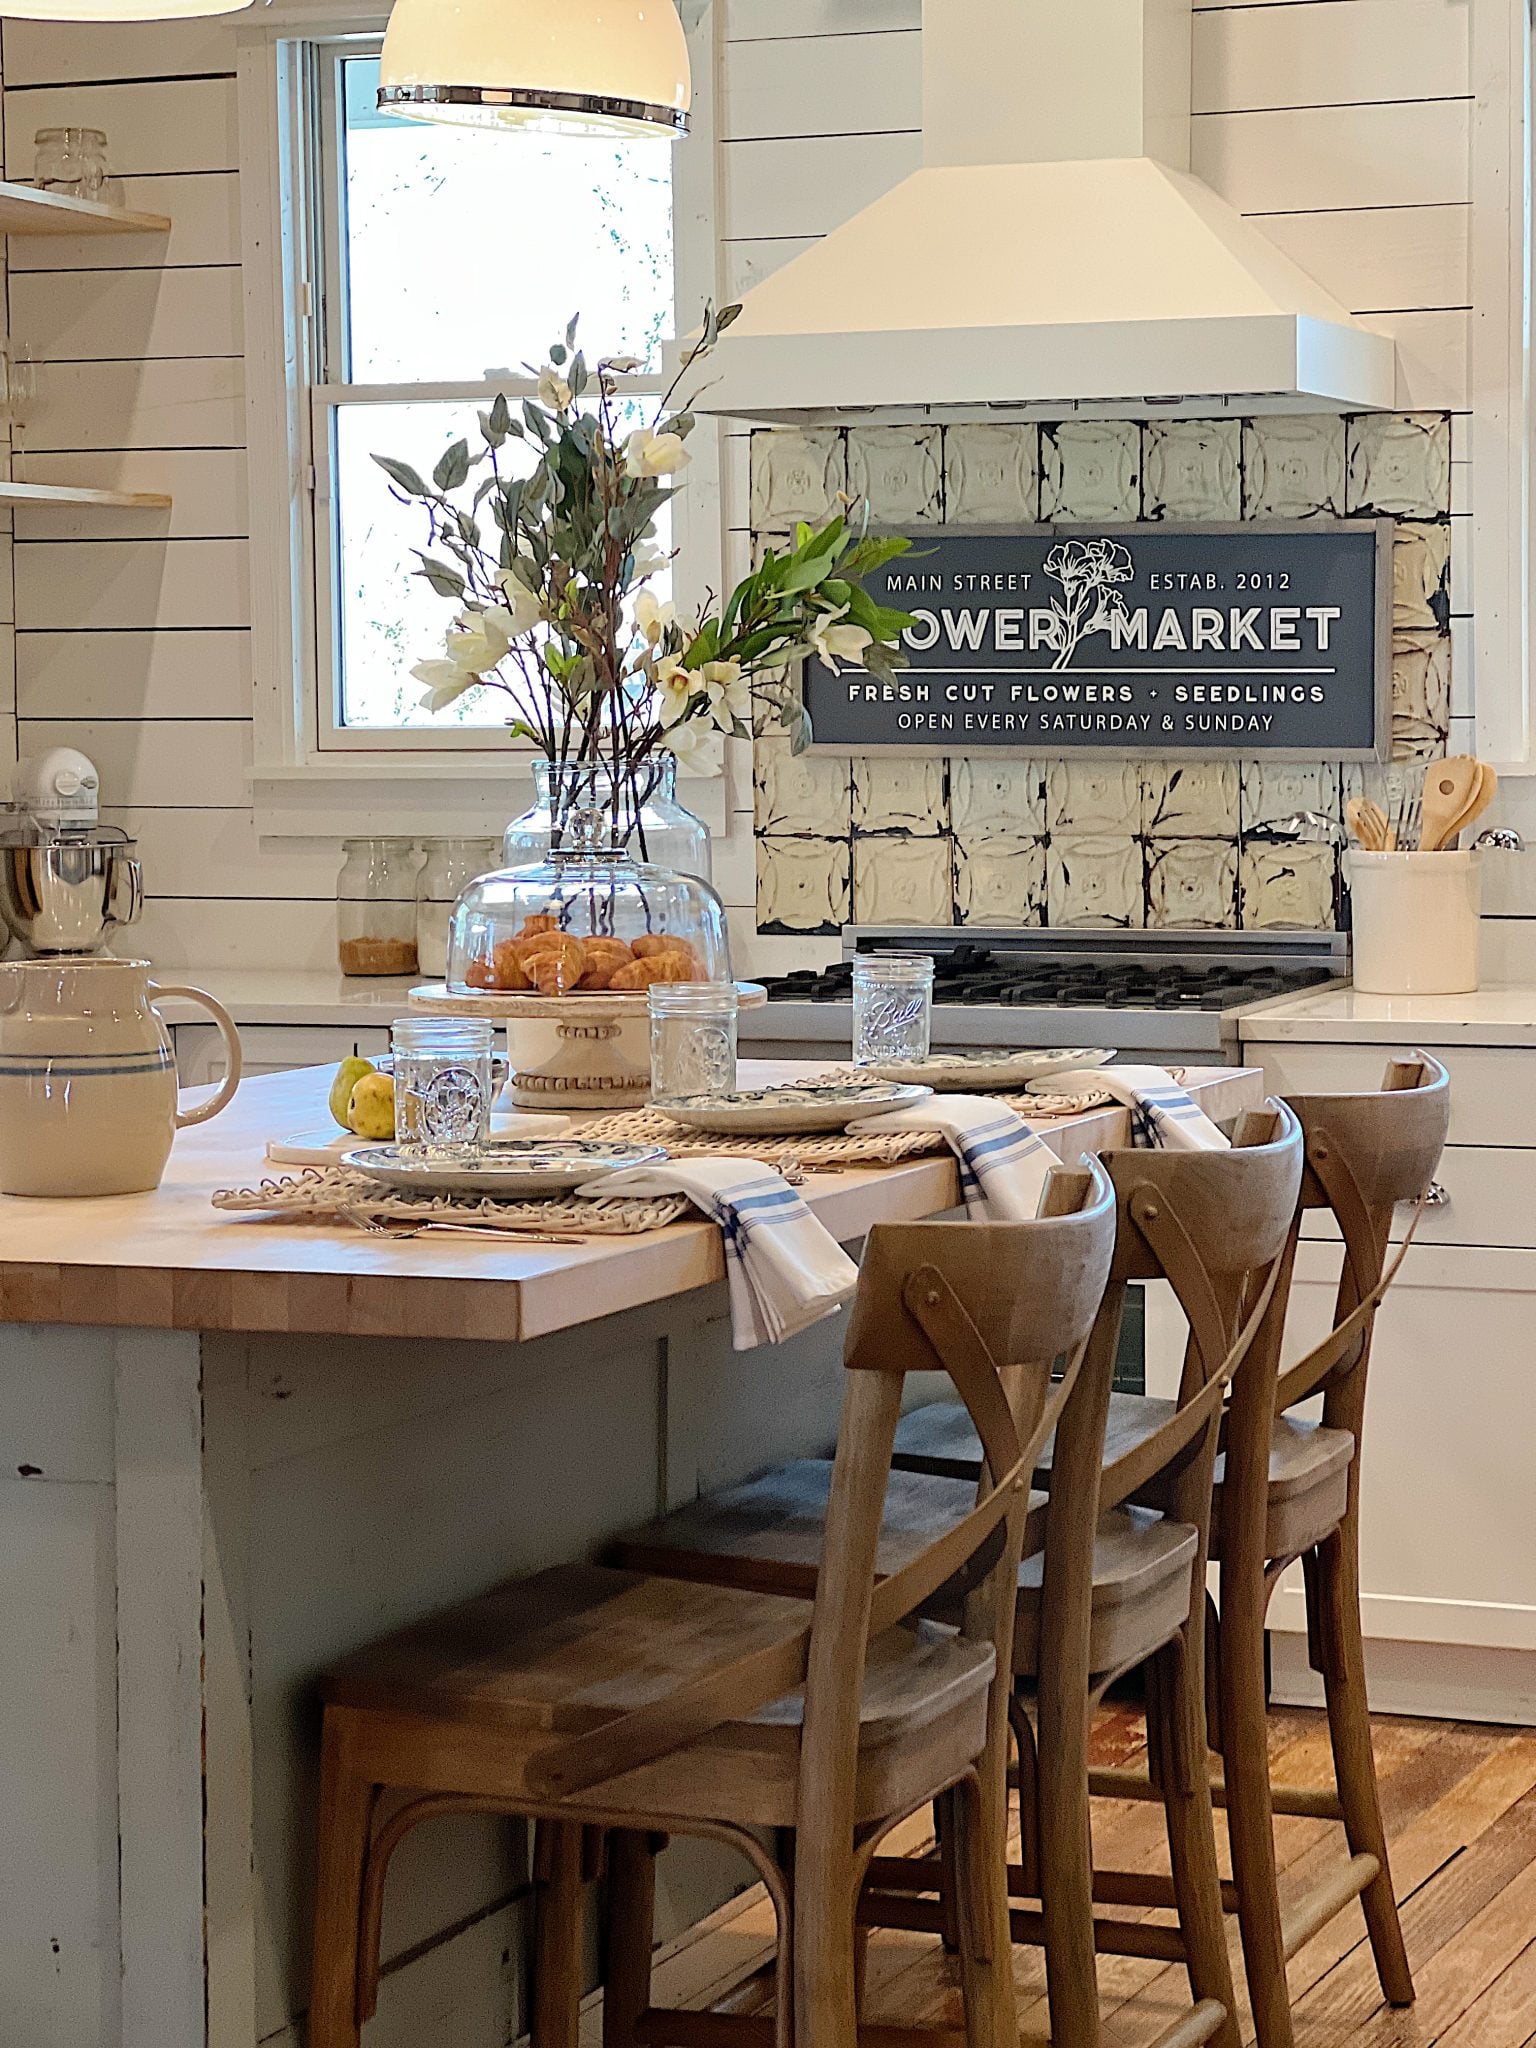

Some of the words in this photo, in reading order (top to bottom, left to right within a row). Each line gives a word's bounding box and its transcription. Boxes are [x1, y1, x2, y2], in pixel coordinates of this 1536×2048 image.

[887, 575, 942, 591] MAIN
[954, 574, 1032, 591] STREET
[1150, 573, 1225, 590] ESTAB.
[1236, 573, 1290, 589] 2012
[880, 608, 1066, 650] OWER
[1110, 607, 1341, 650] MARKET
[849, 685, 929, 701] FRESH
[945, 685, 995, 701] CUT
[1011, 685, 1133, 702] FLOWERS
[1175, 685, 1324, 702] SEEDLINGS
[898, 713, 953, 729] OPEN
[965, 713, 1029, 730] EVERY
[1040, 714, 1151, 731] SATURDAY
[1161, 714, 1174, 730] &
[1185, 714, 1273, 731] SUNDAY
